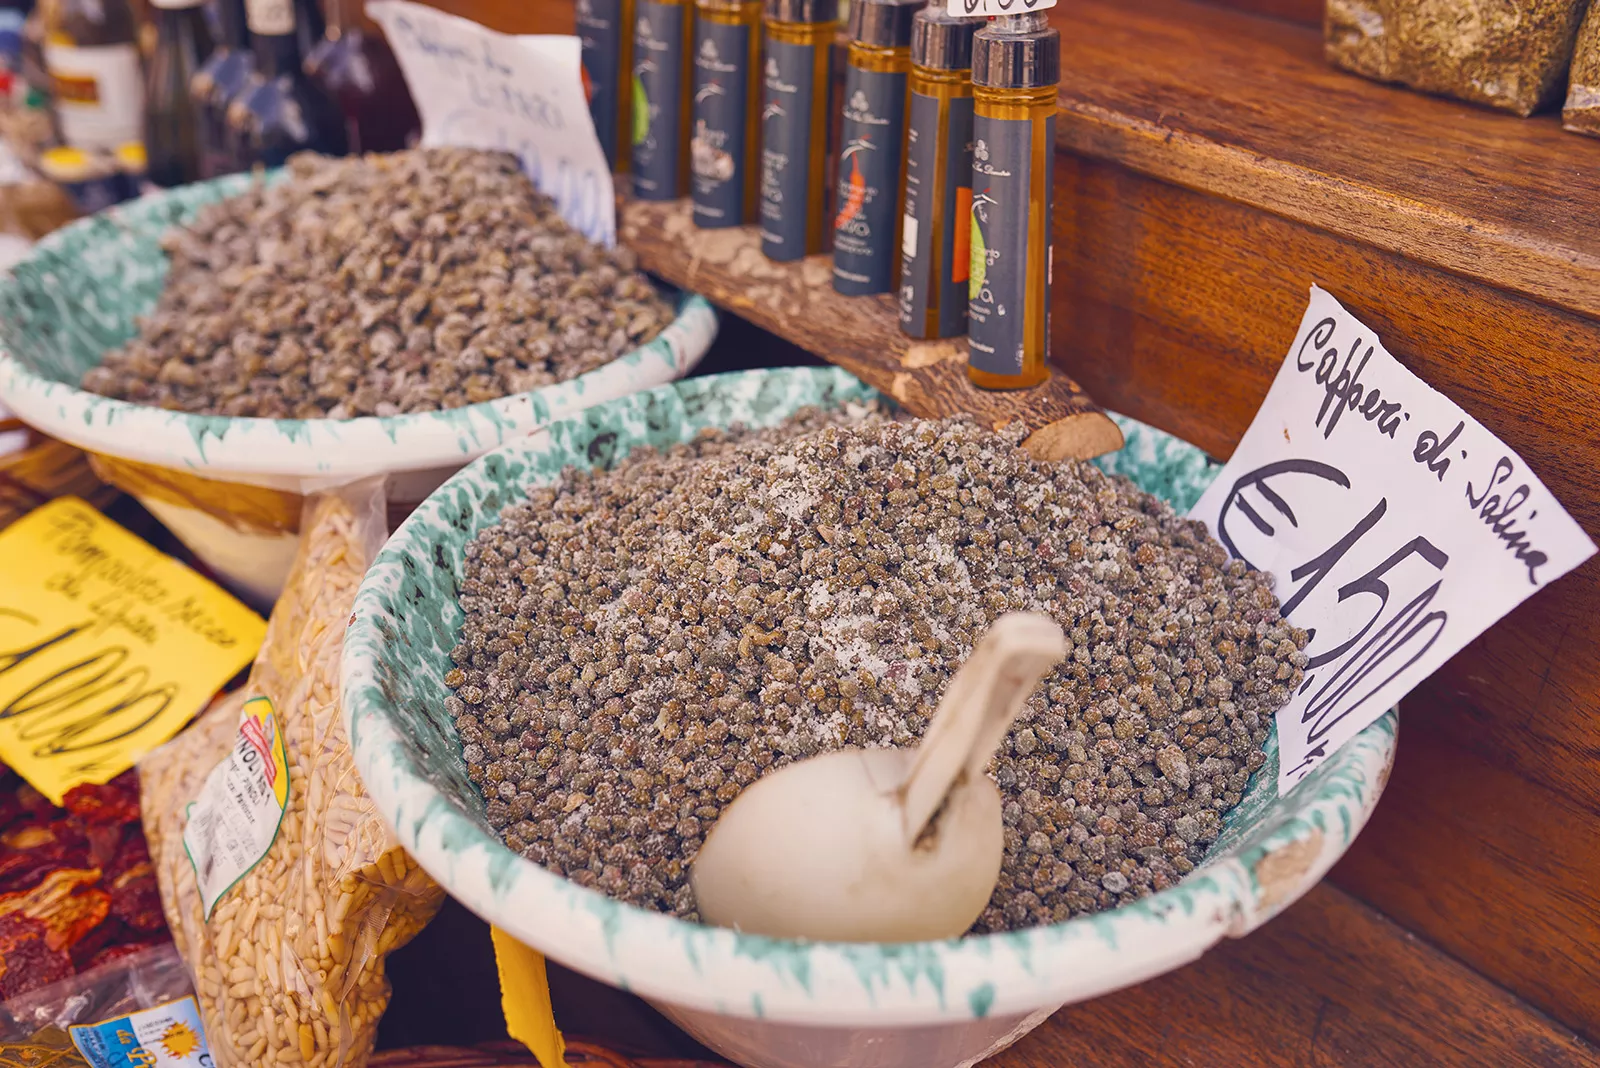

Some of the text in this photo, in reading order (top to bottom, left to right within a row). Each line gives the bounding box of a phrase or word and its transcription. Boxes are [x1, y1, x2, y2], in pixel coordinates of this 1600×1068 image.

[1297, 317, 1550, 586] Capperi di Salina
